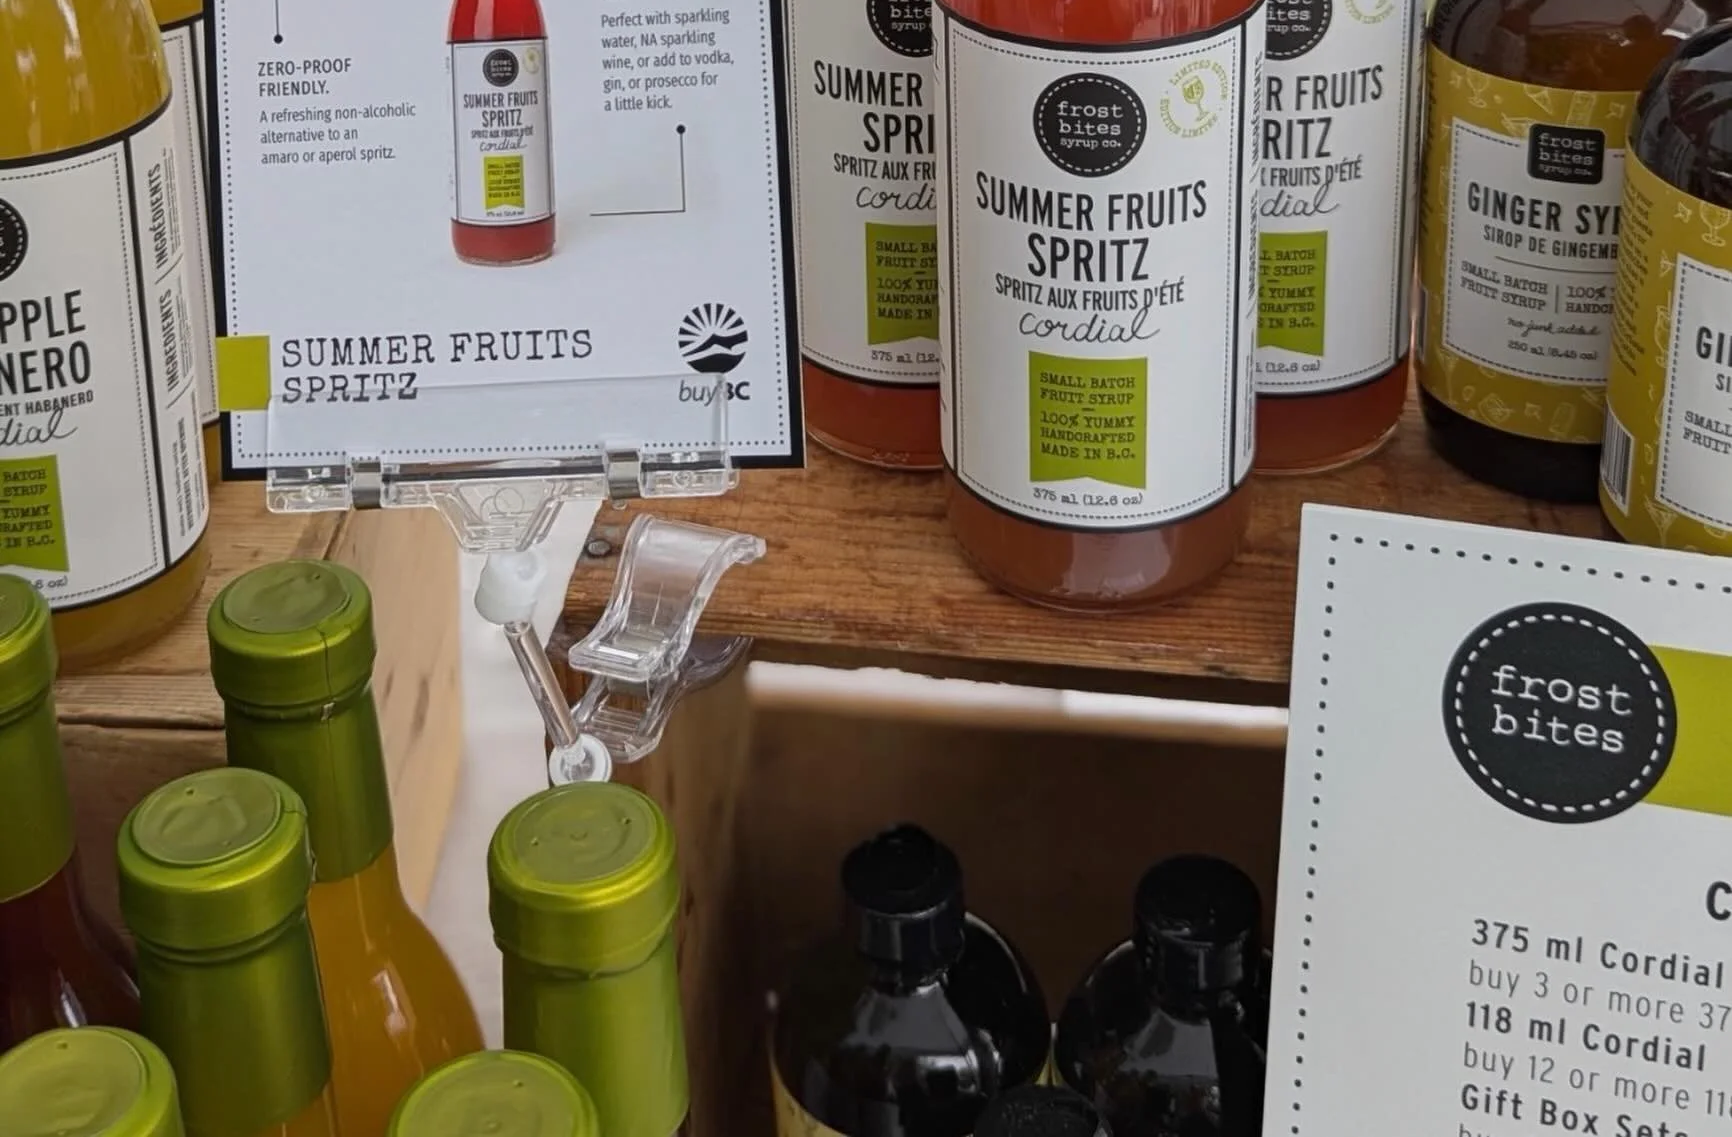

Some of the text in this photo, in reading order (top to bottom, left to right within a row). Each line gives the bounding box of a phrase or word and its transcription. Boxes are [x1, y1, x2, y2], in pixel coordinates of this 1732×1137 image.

[601, 8, 730, 28] Perfect with sparkling
[891, 22, 926, 32] syrup
[601, 29, 716, 49] water, NA sparkling
[257, 57, 352, 77] ZERO-PROOF
[602, 50, 735, 70] wine, or add to vodka,
[259, 79, 330, 97] FRIENDLY.
[603, 71, 719, 94] gin, or prosecco for
[813, 59, 923, 108] SUMMER
[1295, 64, 1383, 111] FRUITS
[463, 90, 539, 109] SUMMER FRUITS
[604, 94, 673, 112] a little kick.
[1057, 101, 1123, 118] frost
[259, 102, 416, 124] A refreshing non-alcoholic
[481, 109, 522, 128] SPRITZ
[260, 127, 358, 144] alternative to an
[863, 111, 935, 155] SPRI
[1059, 120, 1121, 136] bites
[1263, 116, 1333, 160] RITZ
[479, 136, 528, 153] cordial
[1060, 138, 1121, 150] syrup co.
[1538, 132, 1597, 151] frost
[261, 145, 396, 165] amaro or aperol spritz.
[1539, 149, 1593, 165] bites
[834, 152, 910, 181] SPRITZ AUX
[1270, 154, 1363, 187] FRUITS D'ÉTÉ
[976, 171, 1207, 232] SUMMER FRUITS
[1468, 181, 1562, 233] GINGER
[147, 163, 169, 269] INGRÉDIENTS
[875, 241, 918, 254] SMALL
[1483, 224, 1523, 249] SIROP
[1528, 236, 1547, 254] DE
[875, 255, 917, 269] FRUIT
[1028, 232, 1149, 282] SPRITZ
[1275, 249, 1316, 260] BATCH
[1272, 264, 1315, 276] SYRUP
[876, 277, 914, 292] 100%
[1461, 260, 1607, 301] SMALL BATCH 100%
[995, 273, 1185, 311] SPRITZ AUX FRUITS D'ÉTÉ
[1268, 286, 1316, 298] YUMMY
[1460, 276, 1546, 311] FRUIT SYRUP
[877, 307, 914, 320] MADE
[1019, 305, 1160, 344] cordial
[159, 288, 180, 393] INGREDIENTS
[282, 329, 593, 368] SUMMER FRUITS
[282, 372, 418, 403] SPRITZ
[1040, 372, 1136, 389] SMALL BATCH
[25, 389, 94, 415] HABANERO
[1040, 387, 1135, 405] FRUIT SYRUP
[1040, 411, 1136, 429] 100% YUMMY
[1684, 410, 1732, 437] SMALL
[1040, 426, 1136, 444] HANDCRAFTED
[1683, 426, 1732, 455] FRUIT
[1040, 442, 1136, 460] MADE IN B.C.
[3, 468, 47, 484] BATCH
[3, 483, 48, 497] SYRUP
[1033, 487, 1143, 506] 375 ml (12.6 oz)
[3, 504, 51, 519] YUMMY
[1491, 664, 1632, 716] frost
[1491, 703, 1625, 753] bites
[1471, 918, 1723, 989] 375 ml Cordial
[1470, 959, 1519, 998] buy
[1534, 971, 1548, 998] 3
[1564, 982, 1594, 1006] or
[1608, 990, 1684, 1024] more
[1467, 1001, 1706, 1071] 118 ml Cordial
[1464, 1042, 1732, 1116] buy 12 or more 11
[1461, 1083, 1599, 1135] Gift Box
